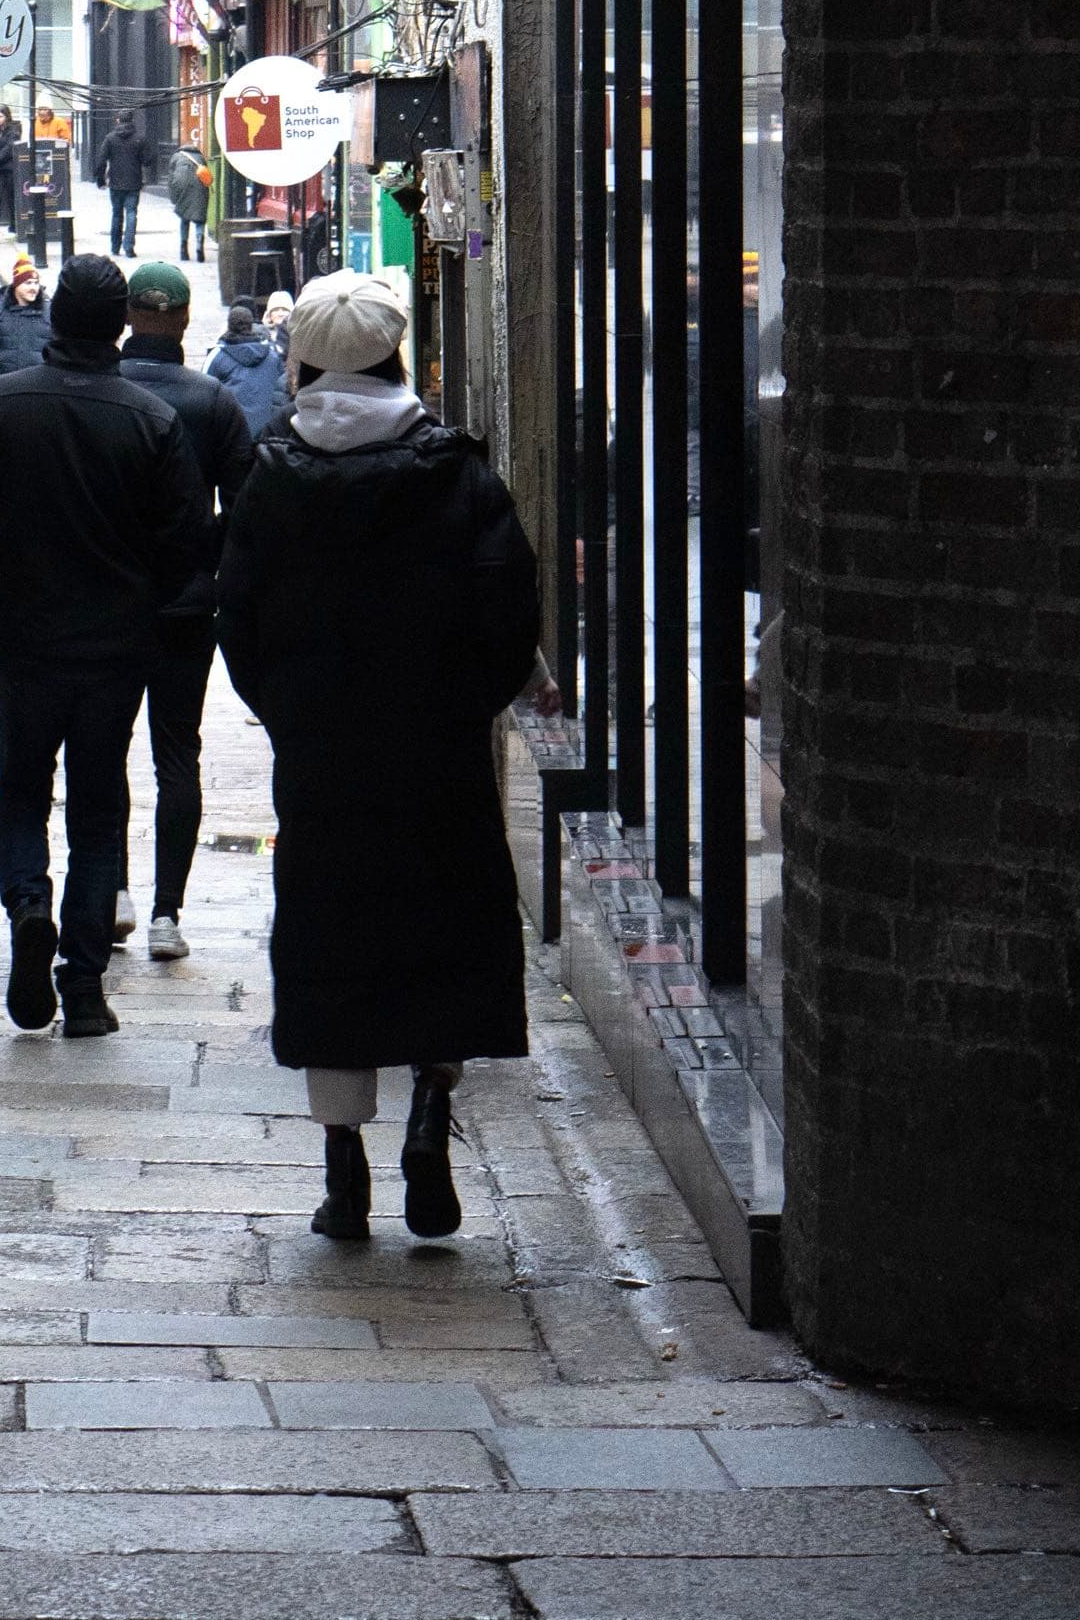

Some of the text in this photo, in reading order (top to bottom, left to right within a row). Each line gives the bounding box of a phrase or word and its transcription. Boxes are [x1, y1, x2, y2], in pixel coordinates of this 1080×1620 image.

[284, 105, 319, 116] South
[284, 117, 340, 127] American
[285, 129, 315, 140] Shop
